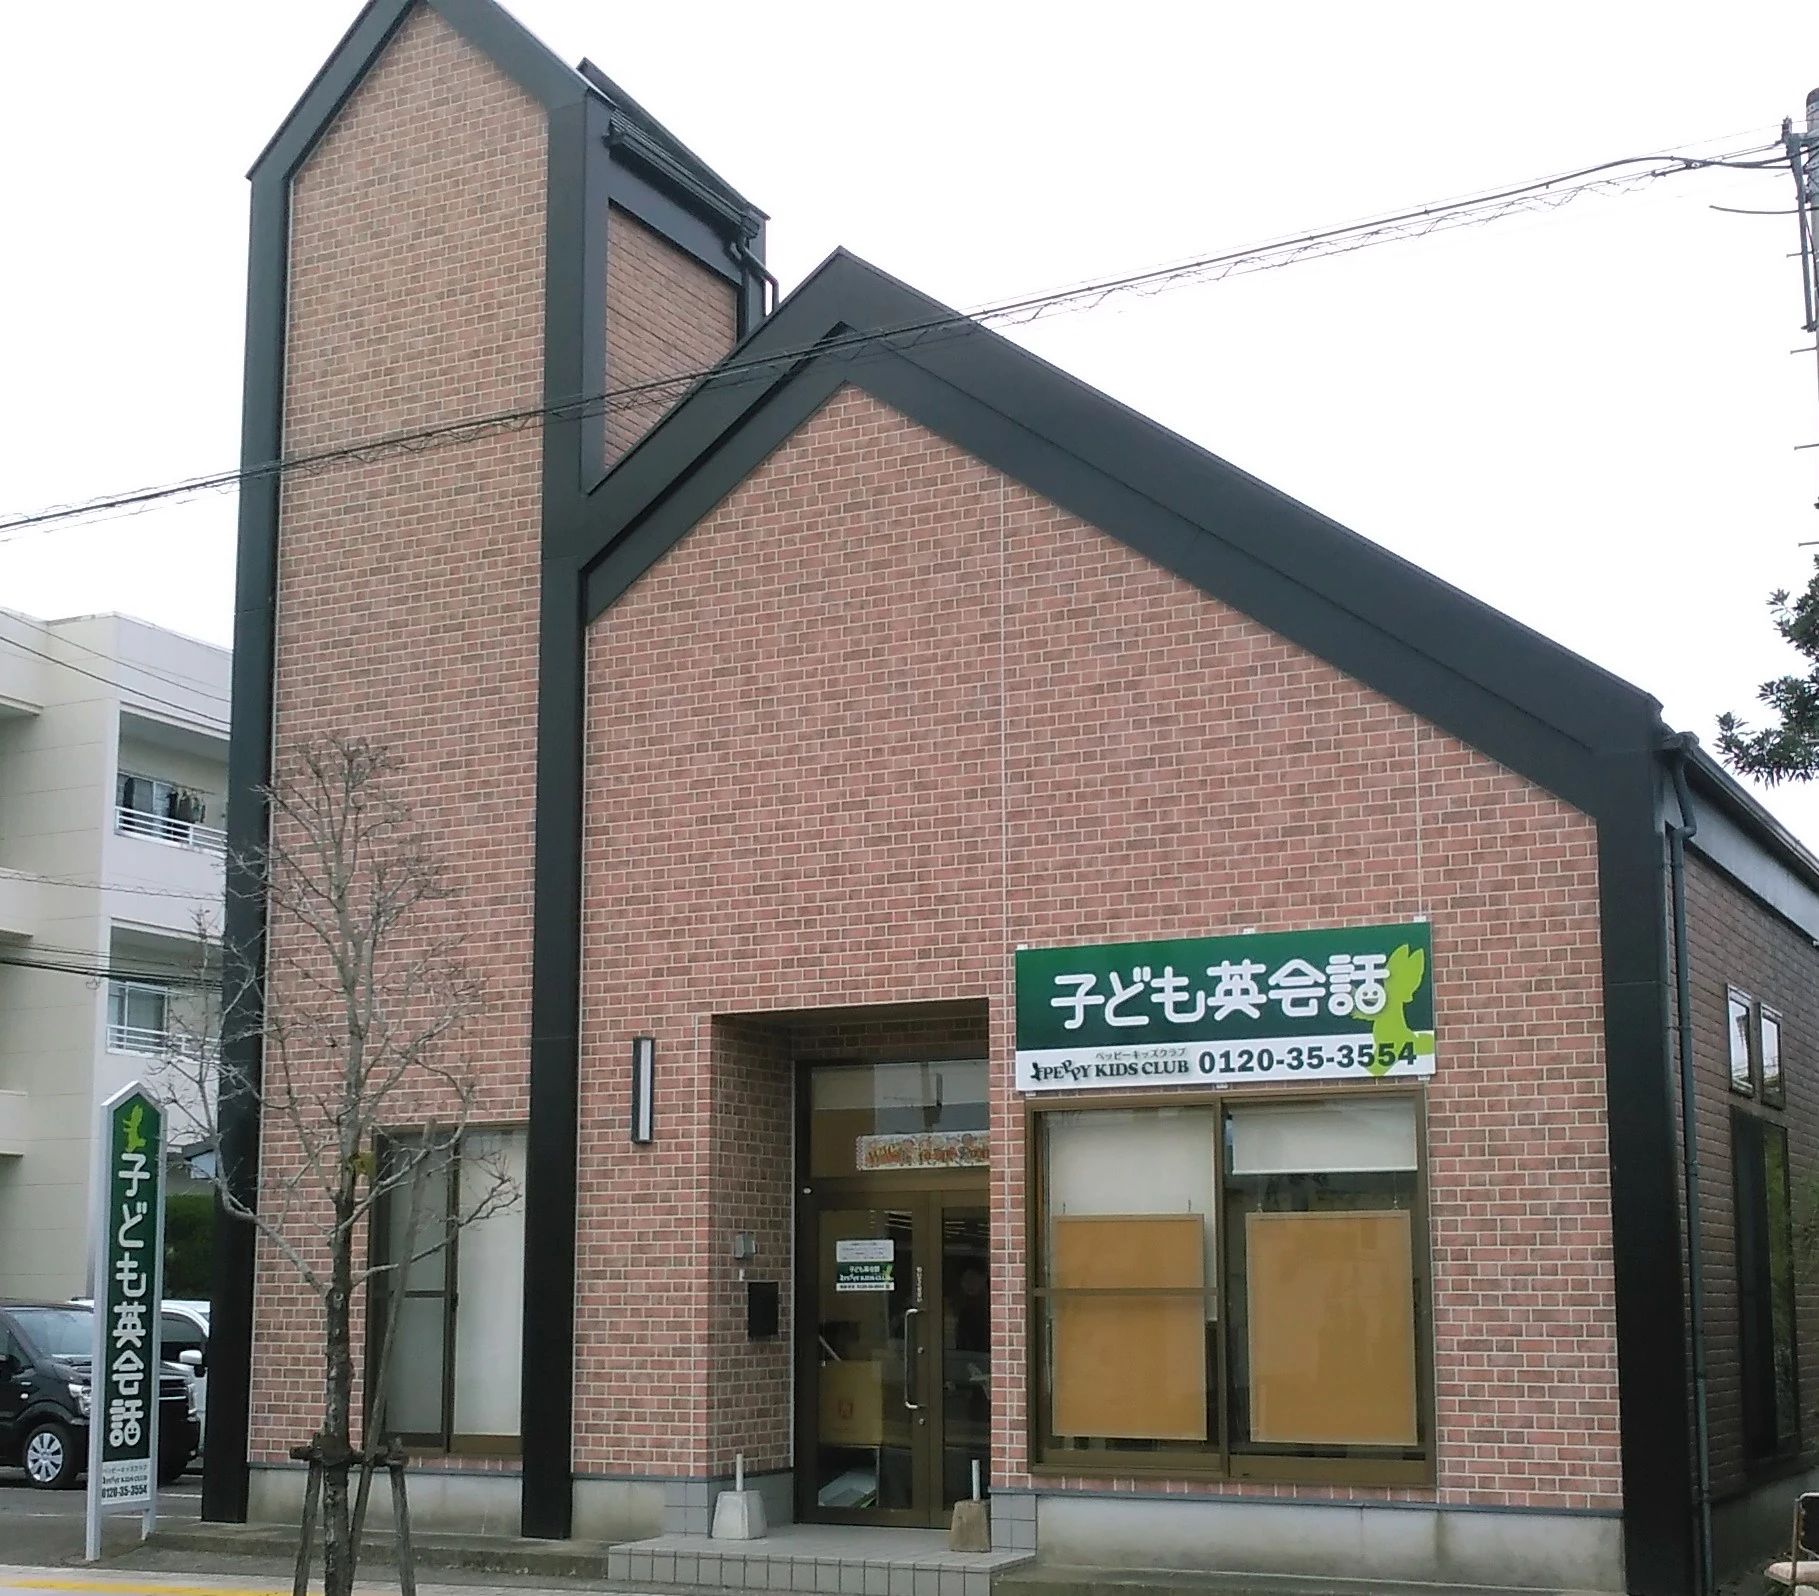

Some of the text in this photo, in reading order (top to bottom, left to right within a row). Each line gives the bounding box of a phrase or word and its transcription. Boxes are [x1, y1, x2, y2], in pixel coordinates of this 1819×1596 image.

[1050, 954, 1390, 1029] 子ども英会話
[1043, 1059, 1189, 1081] PEPPY KIDS CLUB
[1199, 1041, 1417, 1074] 0120-35-3554
[108, 1152, 151, 1447] 子ども英会話
